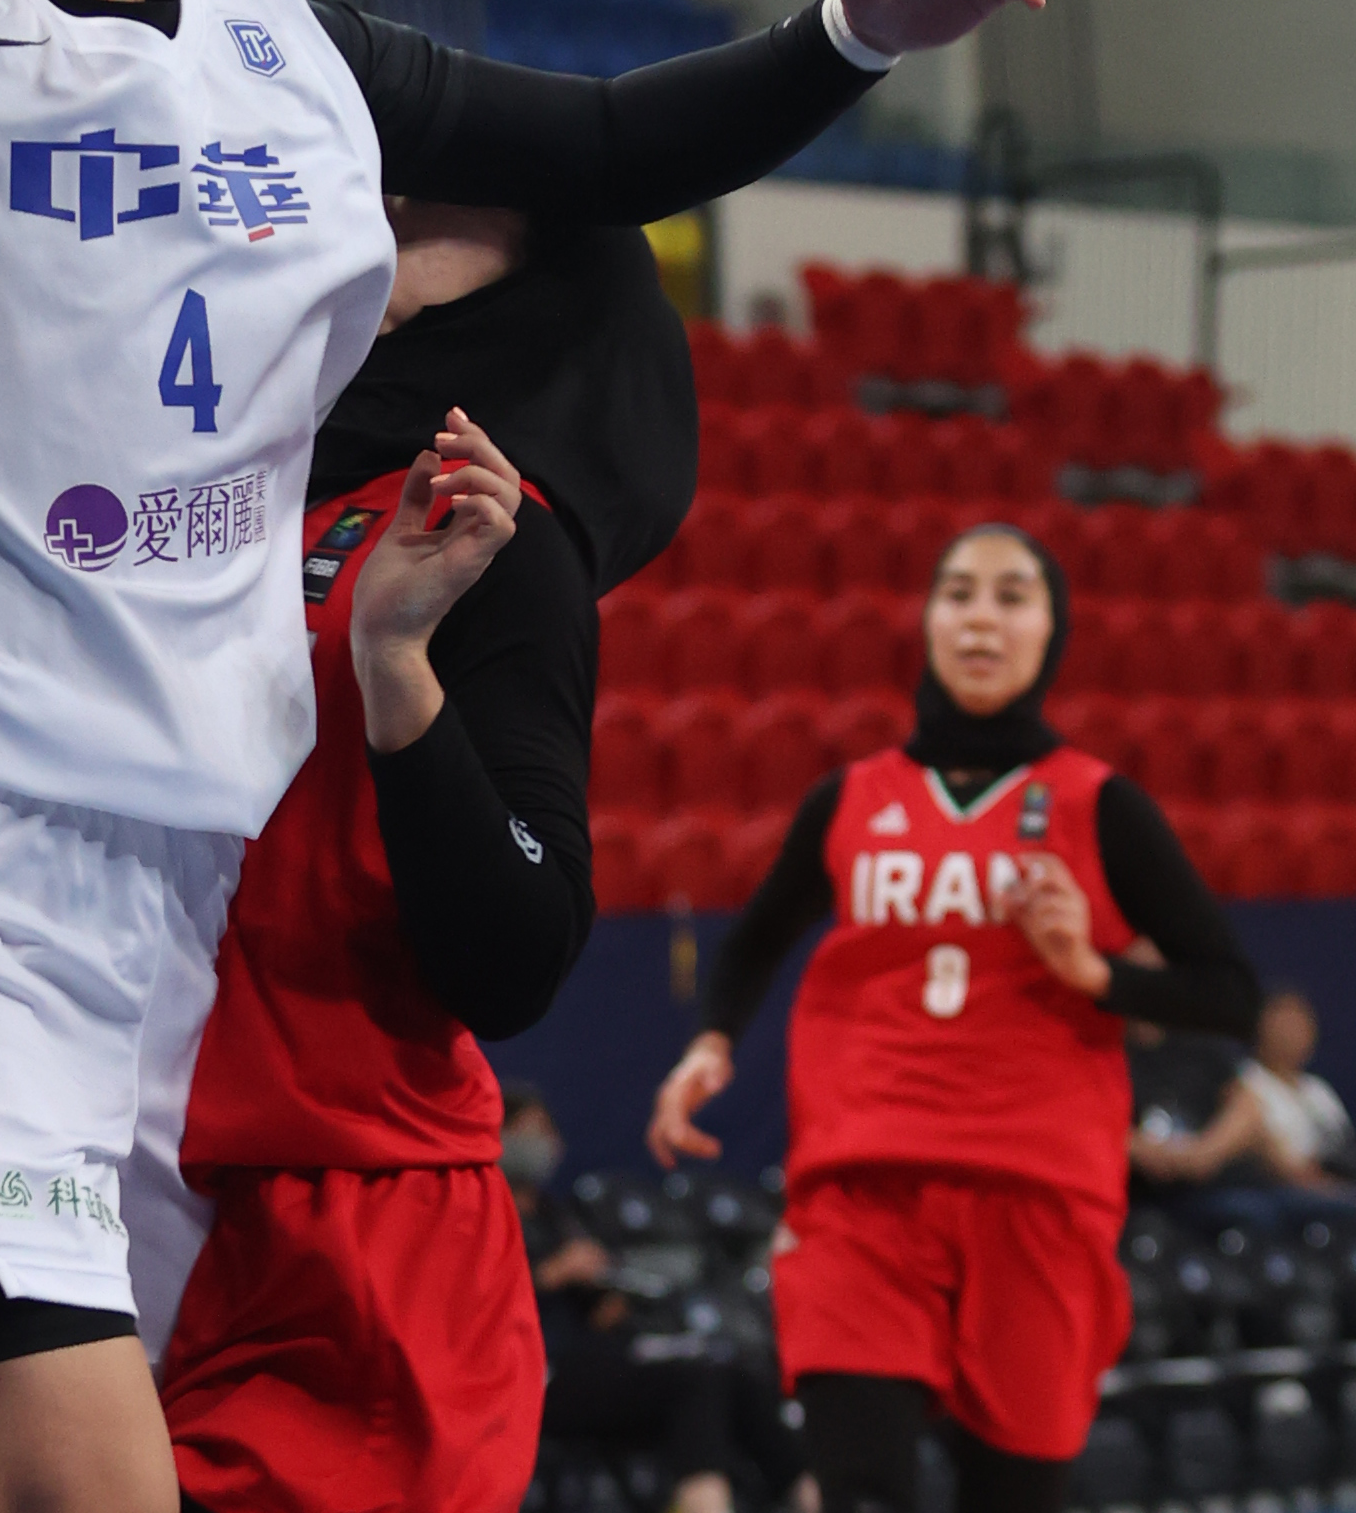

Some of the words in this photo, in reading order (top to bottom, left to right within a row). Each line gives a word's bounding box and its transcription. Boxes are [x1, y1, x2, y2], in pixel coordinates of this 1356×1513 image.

[8, 127, 311, 243] 中華
[157, 287, 223, 433] 4
[133, 472, 256, 567] 愛爾麗
